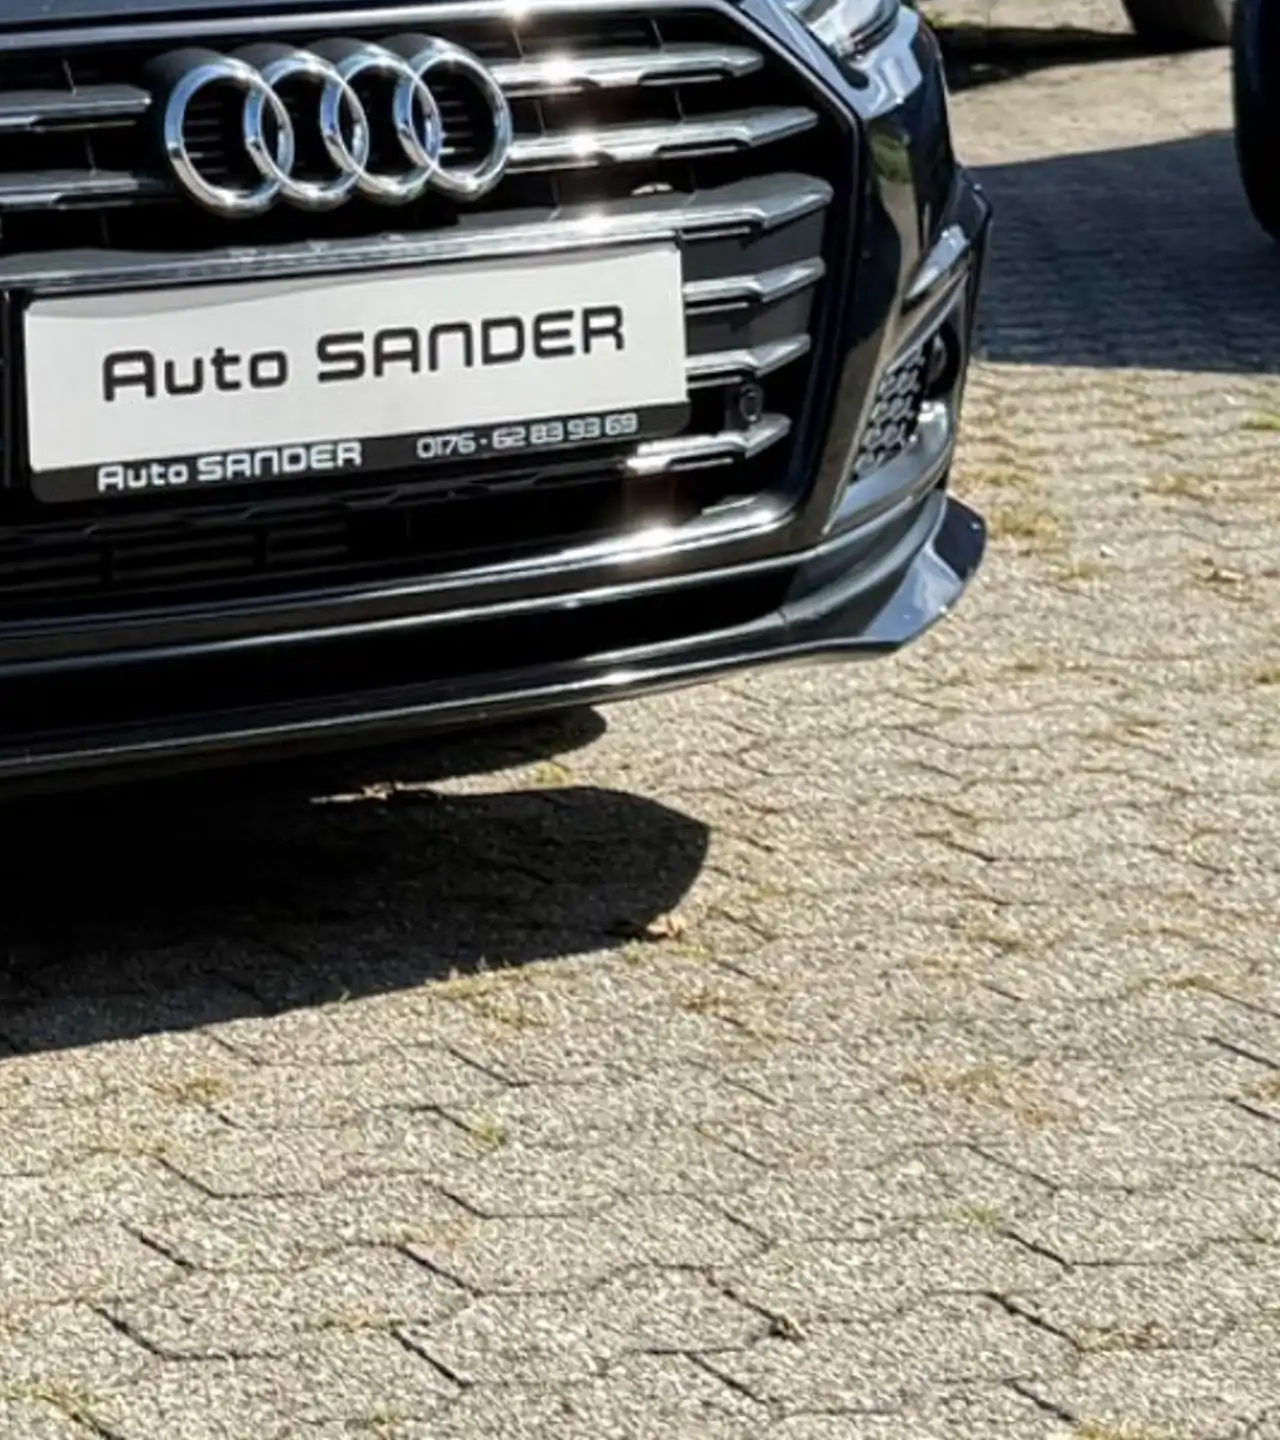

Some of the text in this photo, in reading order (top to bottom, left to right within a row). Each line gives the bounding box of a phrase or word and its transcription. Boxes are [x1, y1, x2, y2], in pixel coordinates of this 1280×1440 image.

[102, 304, 625, 402] Auto SANDER
[97, 441, 362, 493] Auto SANDER
[416, 431, 476, 459] 0176
[492, 425, 526, 450] 62
